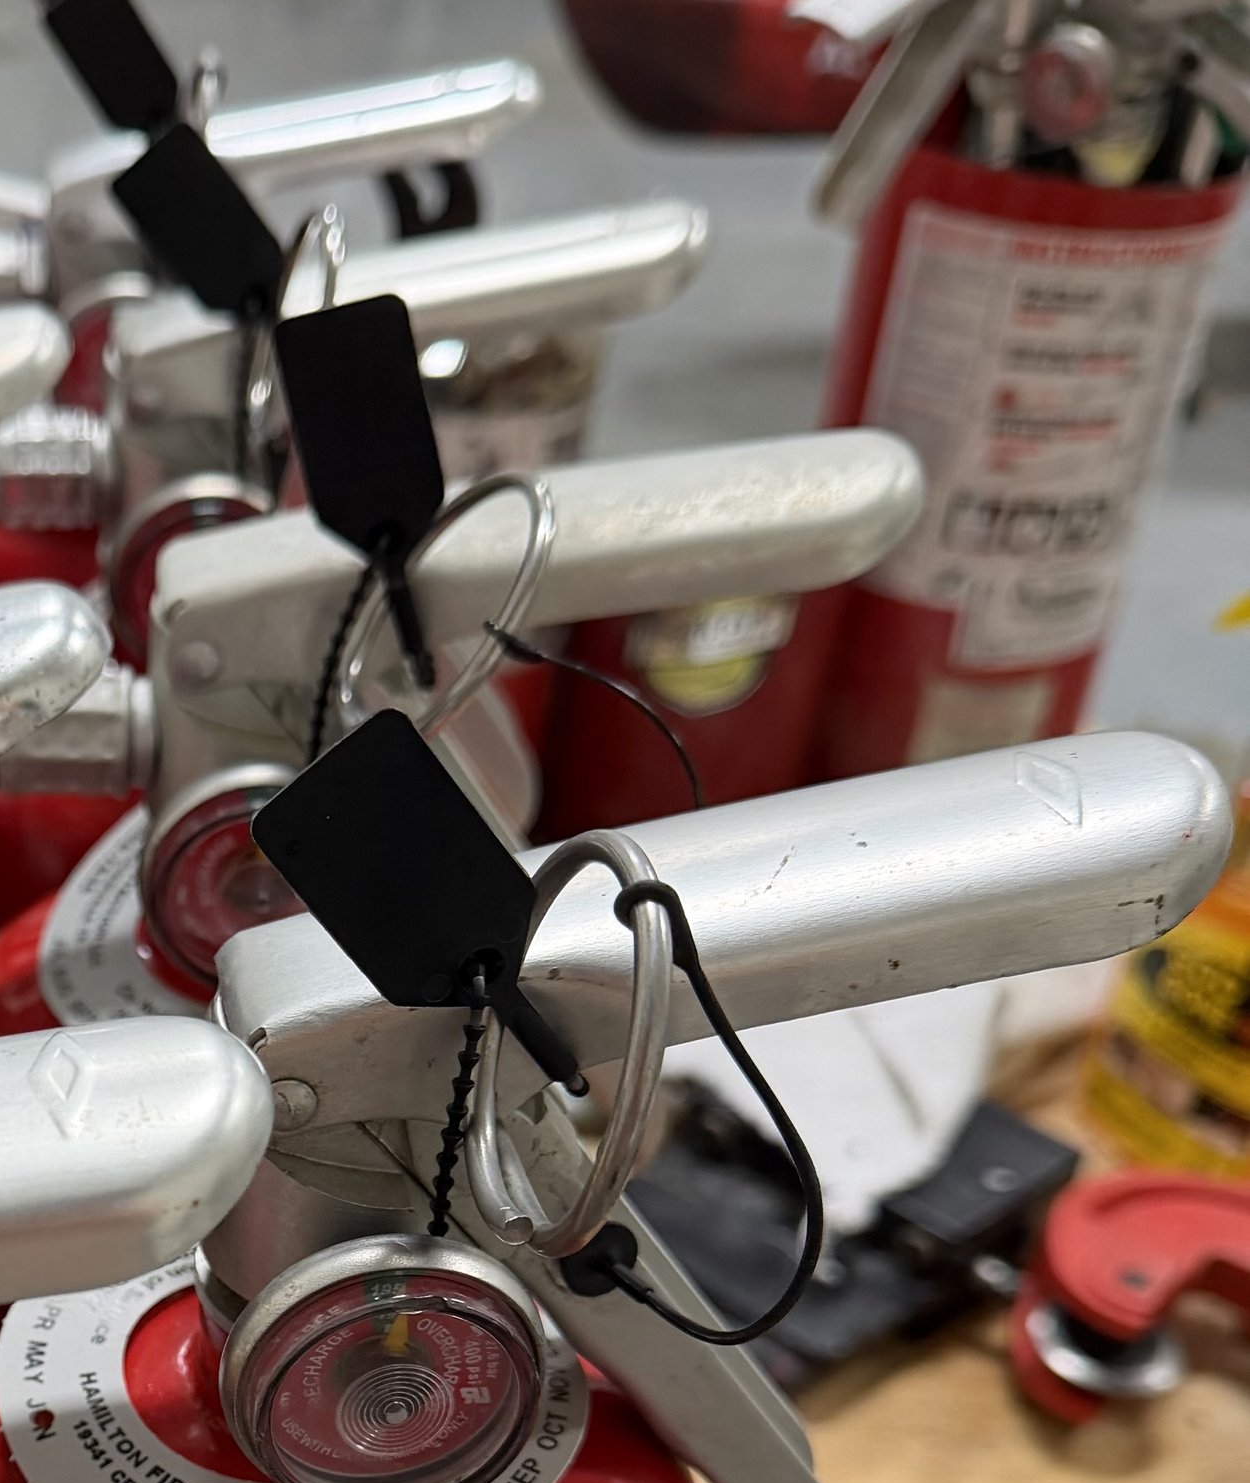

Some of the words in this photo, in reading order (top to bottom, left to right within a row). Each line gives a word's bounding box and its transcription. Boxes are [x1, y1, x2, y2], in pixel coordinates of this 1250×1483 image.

[33, 1302, 62, 1331] PR
[23, 1340, 48, 1385] MAY
[550, 1368, 570, 1404] NO
[25, 1397, 57, 1442] JN
[79, 1371, 149, 1468] HAMILTON
[537, 1412, 568, 1452] OCT
[73, 1420, 113, 1470] 19341
